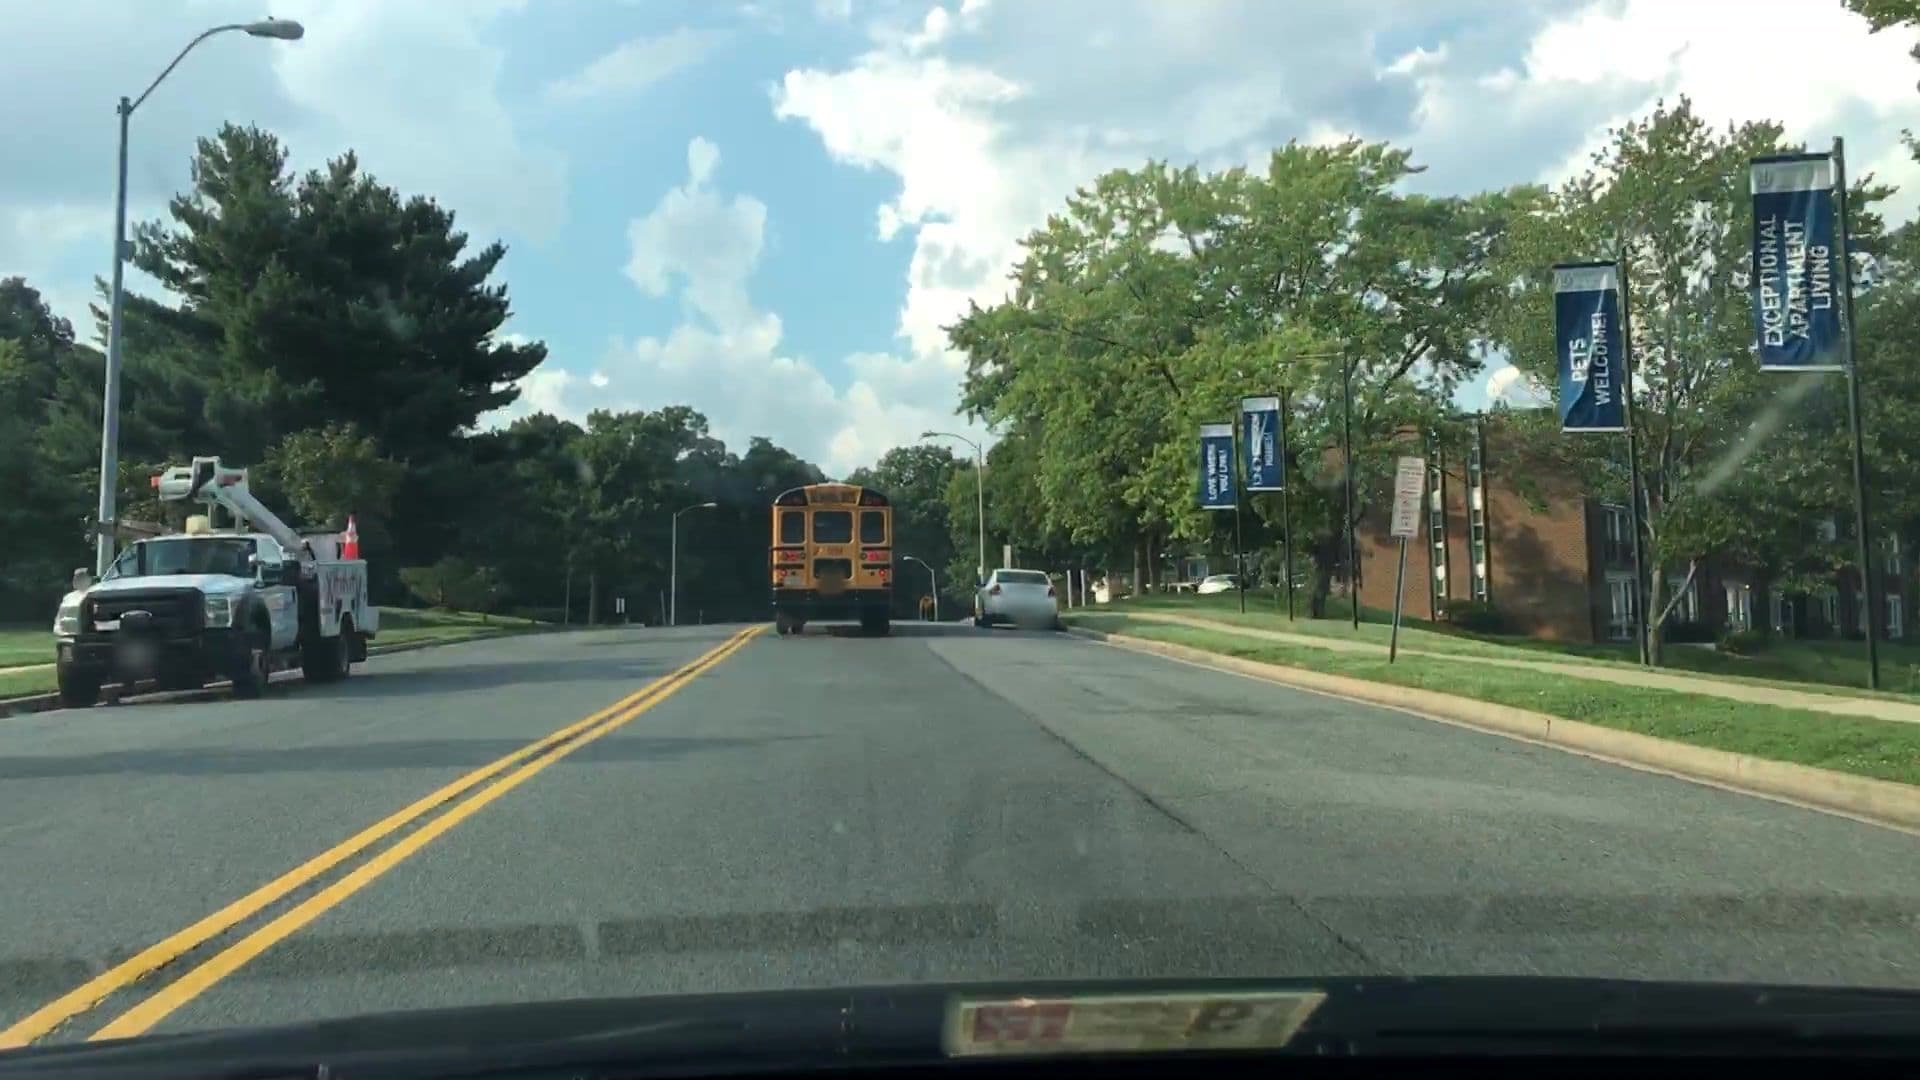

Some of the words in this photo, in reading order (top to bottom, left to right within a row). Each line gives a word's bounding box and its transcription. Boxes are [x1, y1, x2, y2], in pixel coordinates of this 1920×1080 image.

[1760, 214, 1784, 347] EXCEPTIONAL
[1784, 220, 1809, 339] APARTMENT
[1809, 245, 1832, 310] LIVING
[1569, 338, 1588, 382] PETS
[1591, 312, 1611, 406] WELCOME!
[1207, 478, 1217, 500] LOVE
[1218, 474, 1228, 493] YOU
